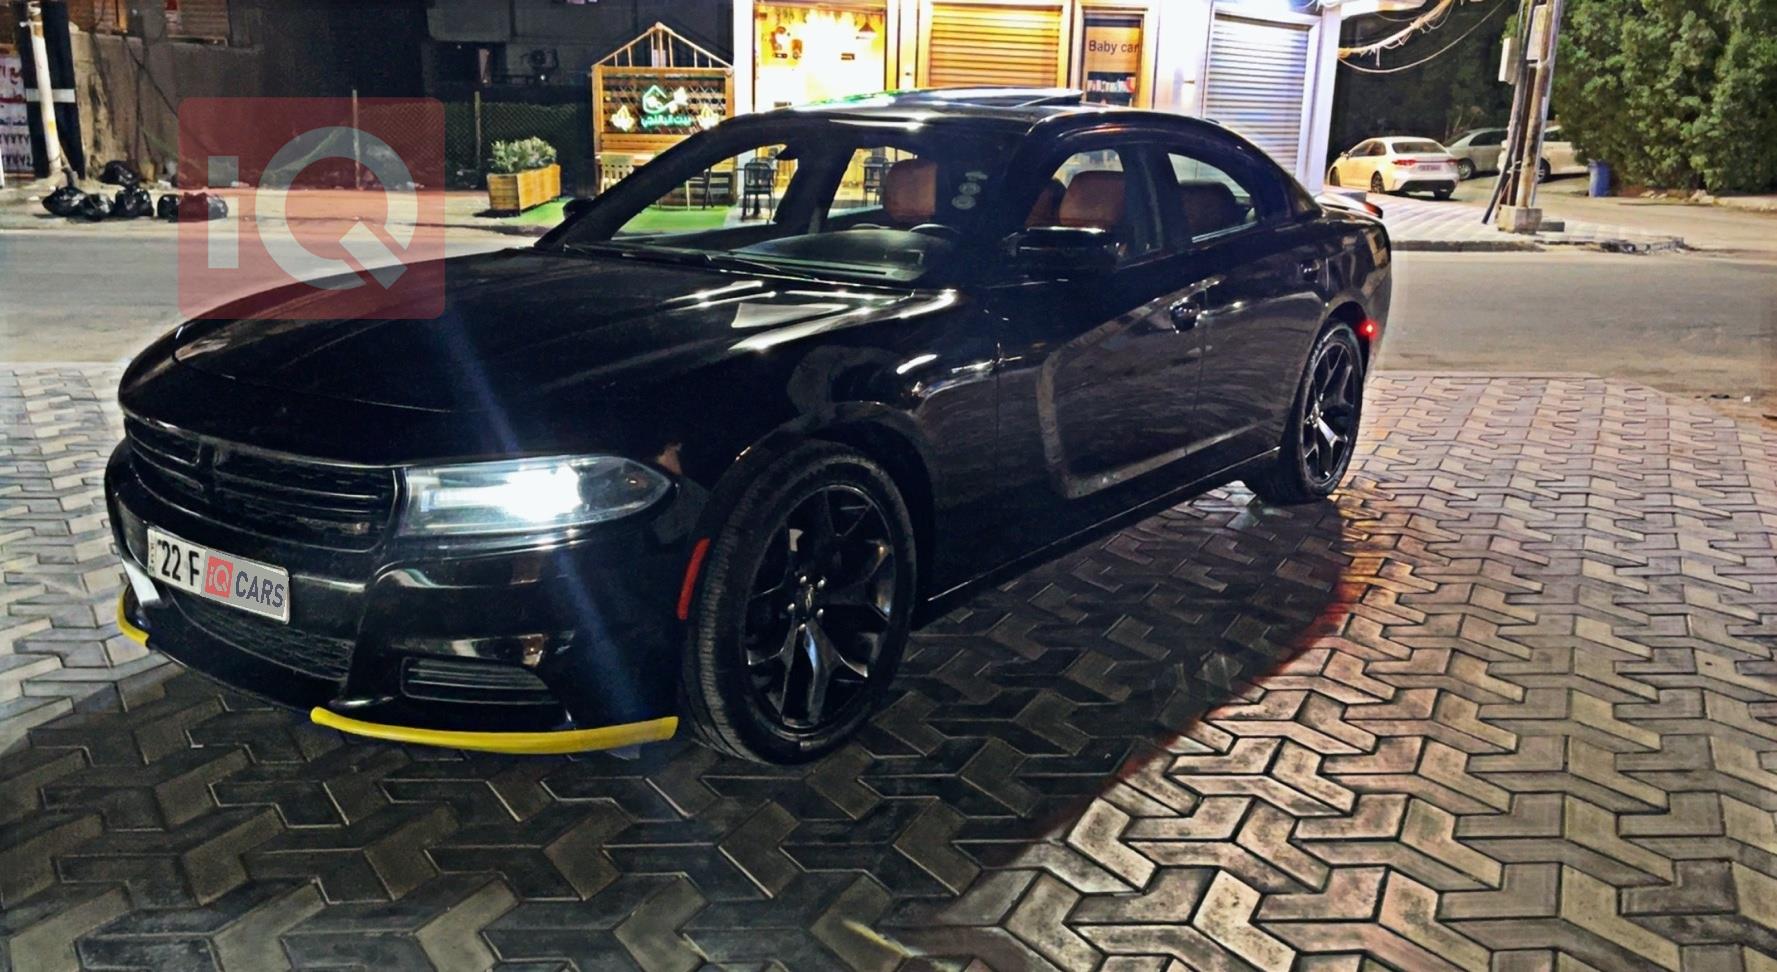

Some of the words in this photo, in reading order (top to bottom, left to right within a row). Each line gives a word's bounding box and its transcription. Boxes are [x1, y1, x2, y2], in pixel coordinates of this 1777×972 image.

[1088, 39, 1118, 56] Baby
[161, 539, 181, 582] 22
[188, 549, 200, 586] F
